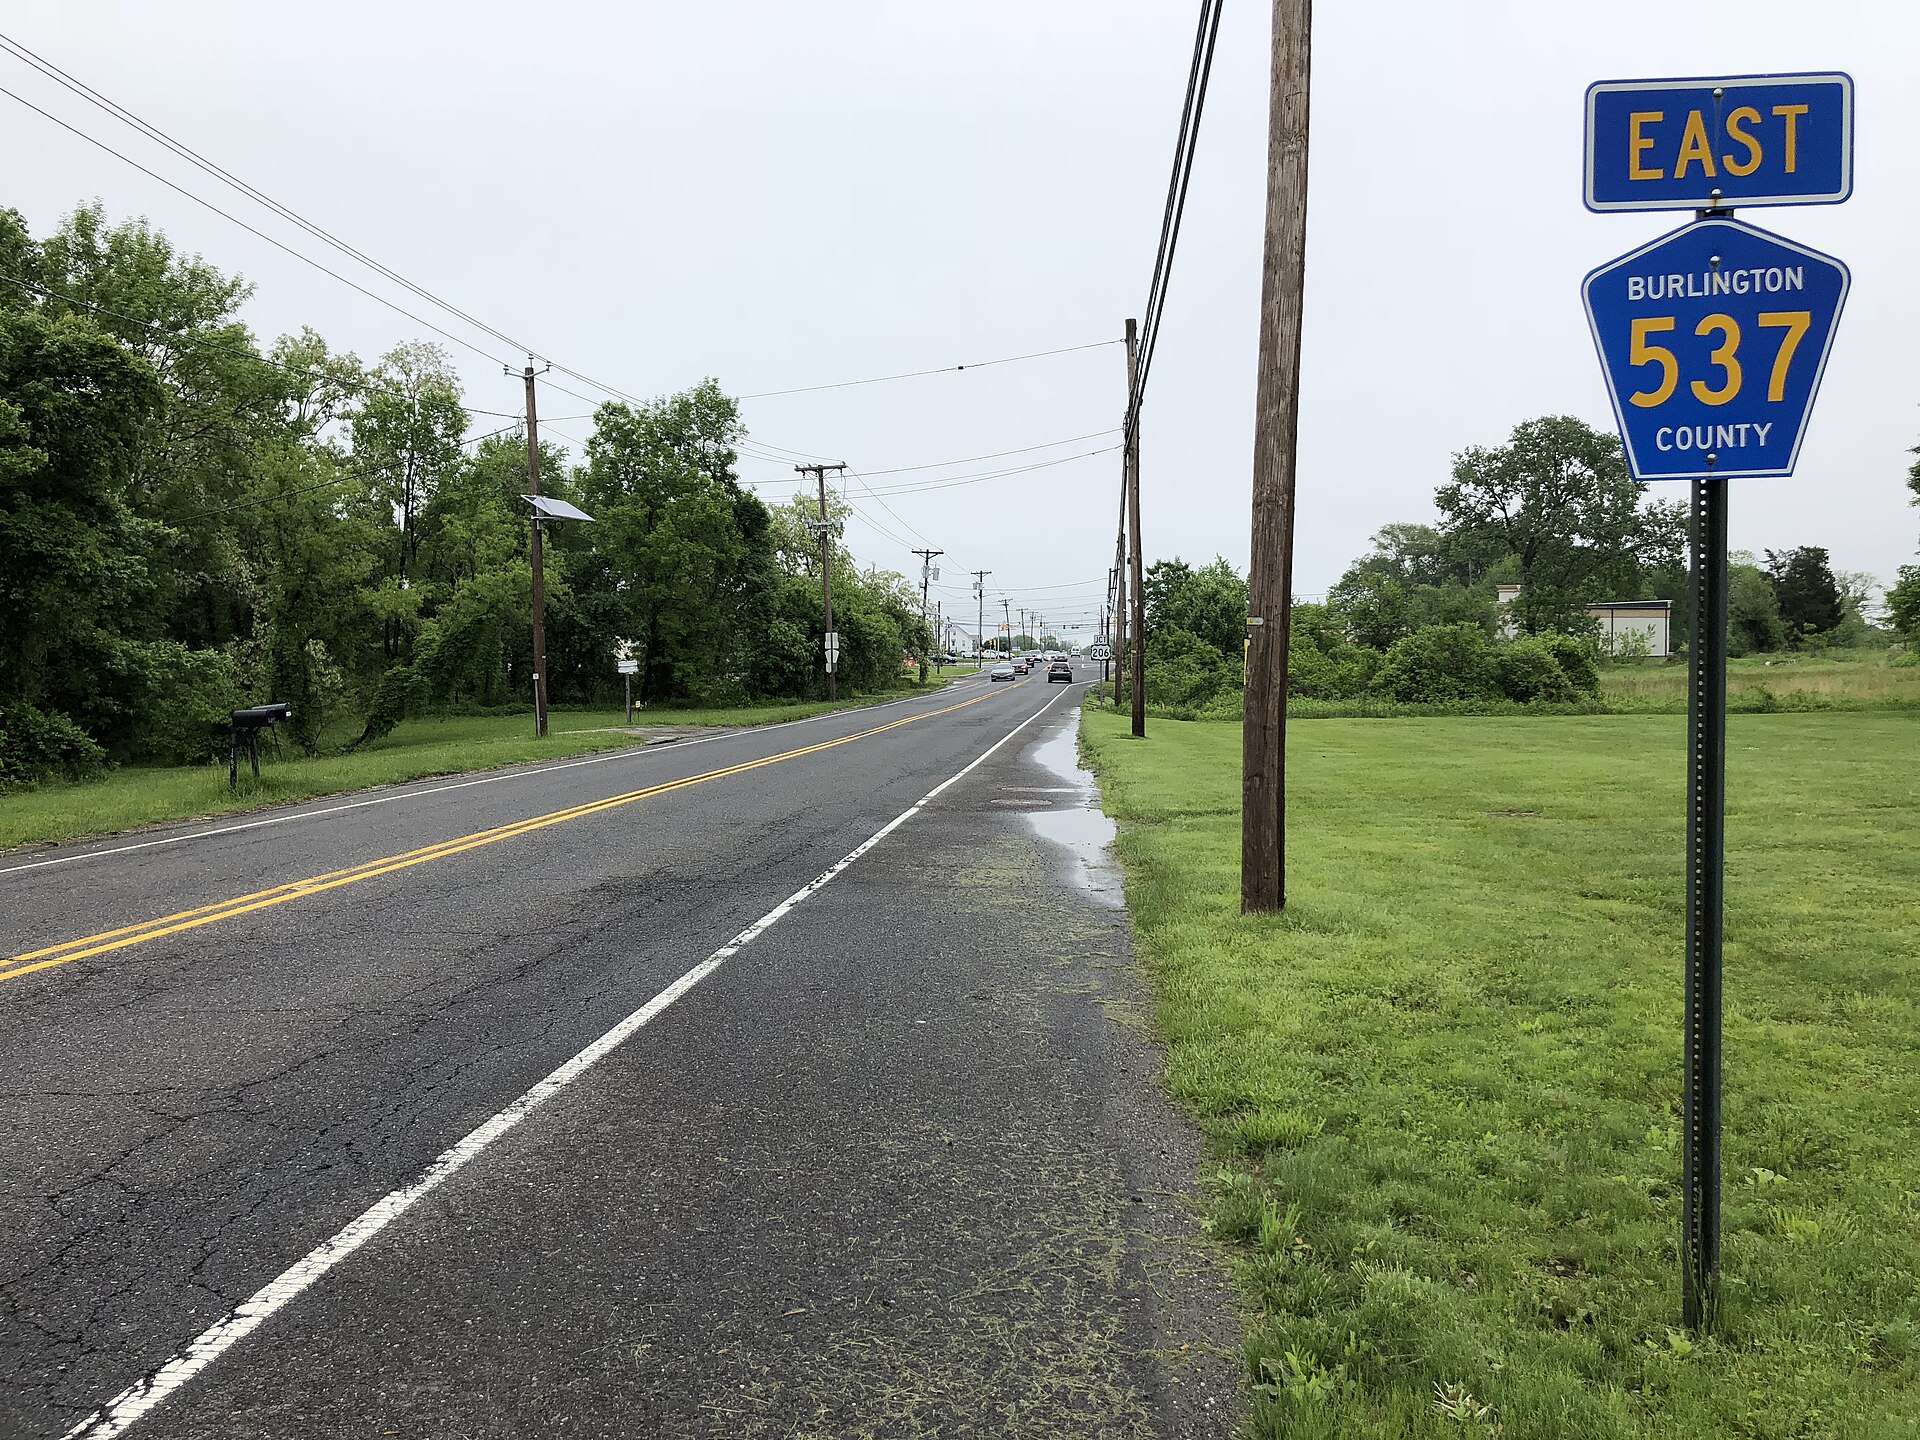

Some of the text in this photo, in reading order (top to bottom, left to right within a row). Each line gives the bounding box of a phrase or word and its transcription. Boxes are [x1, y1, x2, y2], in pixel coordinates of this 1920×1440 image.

[1628, 104, 1809, 181] EAST
[1628, 266, 1804, 300] BURLINGTON
[1628, 311, 1811, 408] 537
[1655, 422, 1773, 452] COUNTY
[1092, 648, 1109, 657] 206
[1095, 636, 1106, 644] JCT
